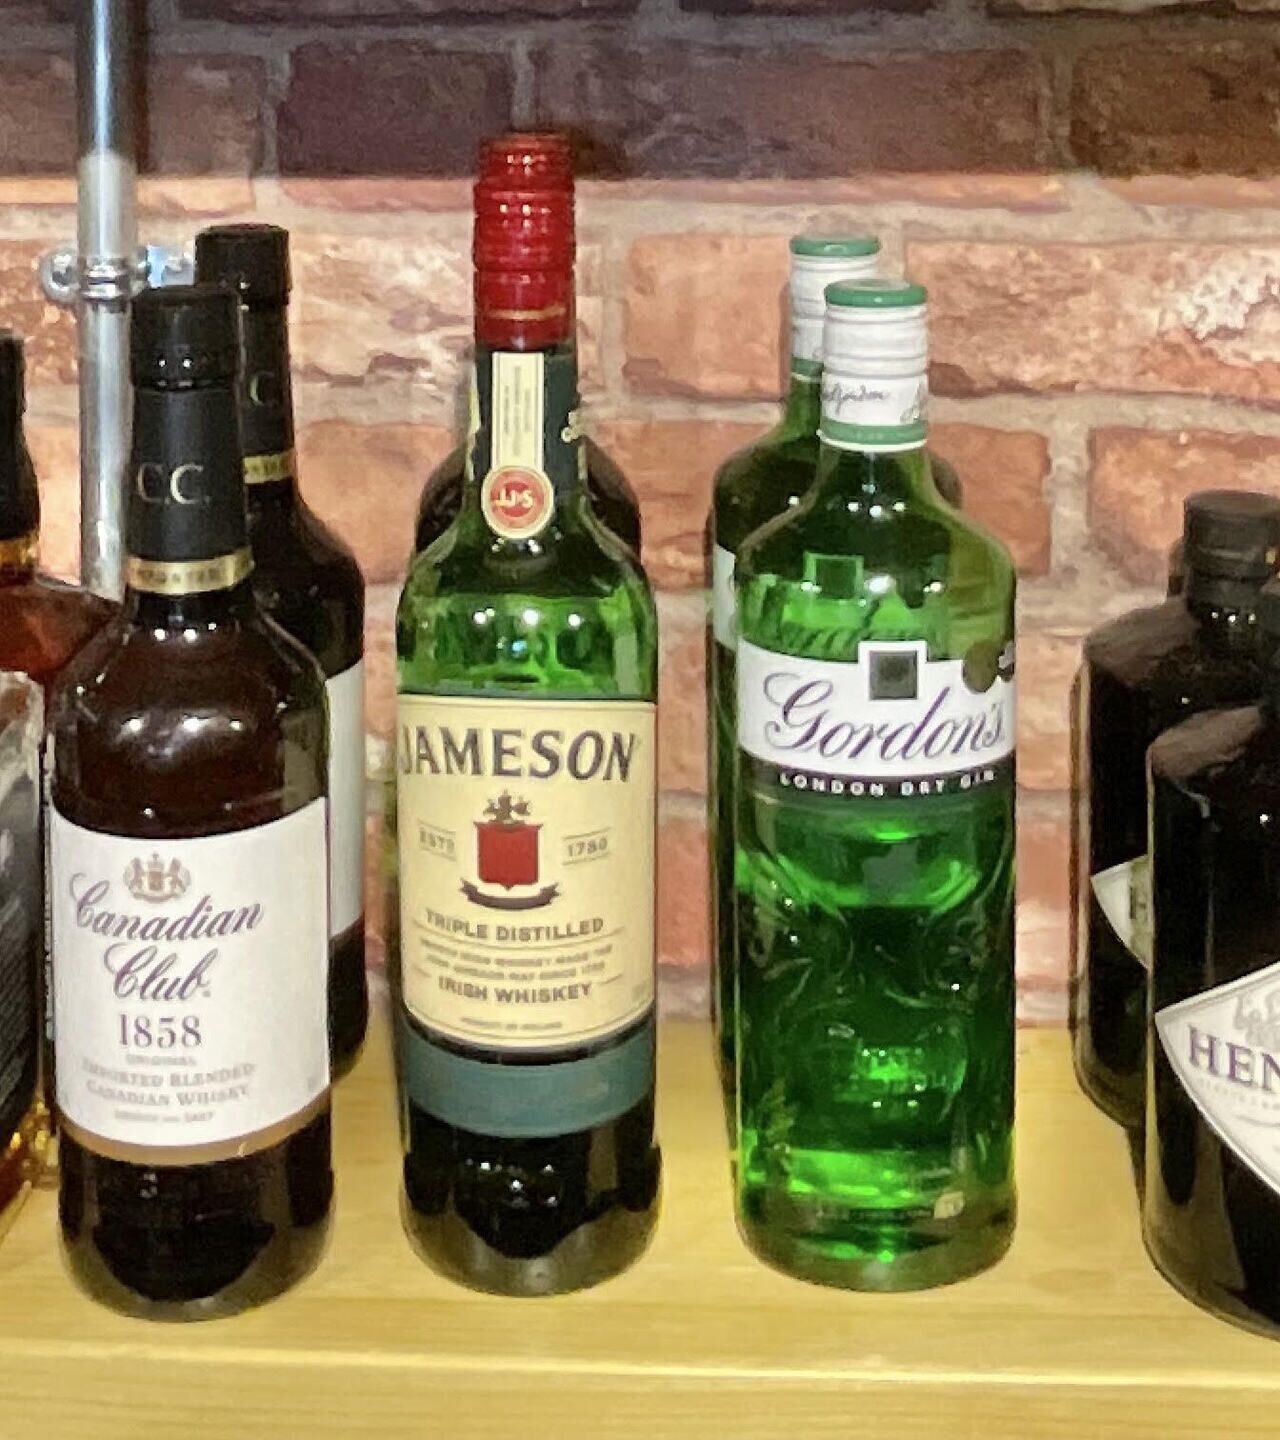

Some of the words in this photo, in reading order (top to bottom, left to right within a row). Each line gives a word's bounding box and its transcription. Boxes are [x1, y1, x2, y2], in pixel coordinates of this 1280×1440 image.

[763, 671, 1006, 762] Gordon's
[401, 724, 638, 783] JAMESON
[778, 771, 885, 798] LONDON
[69, 872, 265, 943] Canadian
[425, 907, 489, 940] TRIPLE
[495, 917, 605, 942] DISTILLED
[103, 942, 220, 1002] Club
[437, 974, 488, 1001] IRISH
[494, 981, 594, 1004] WHISKEY
[118, 1013, 203, 1050] 1858
